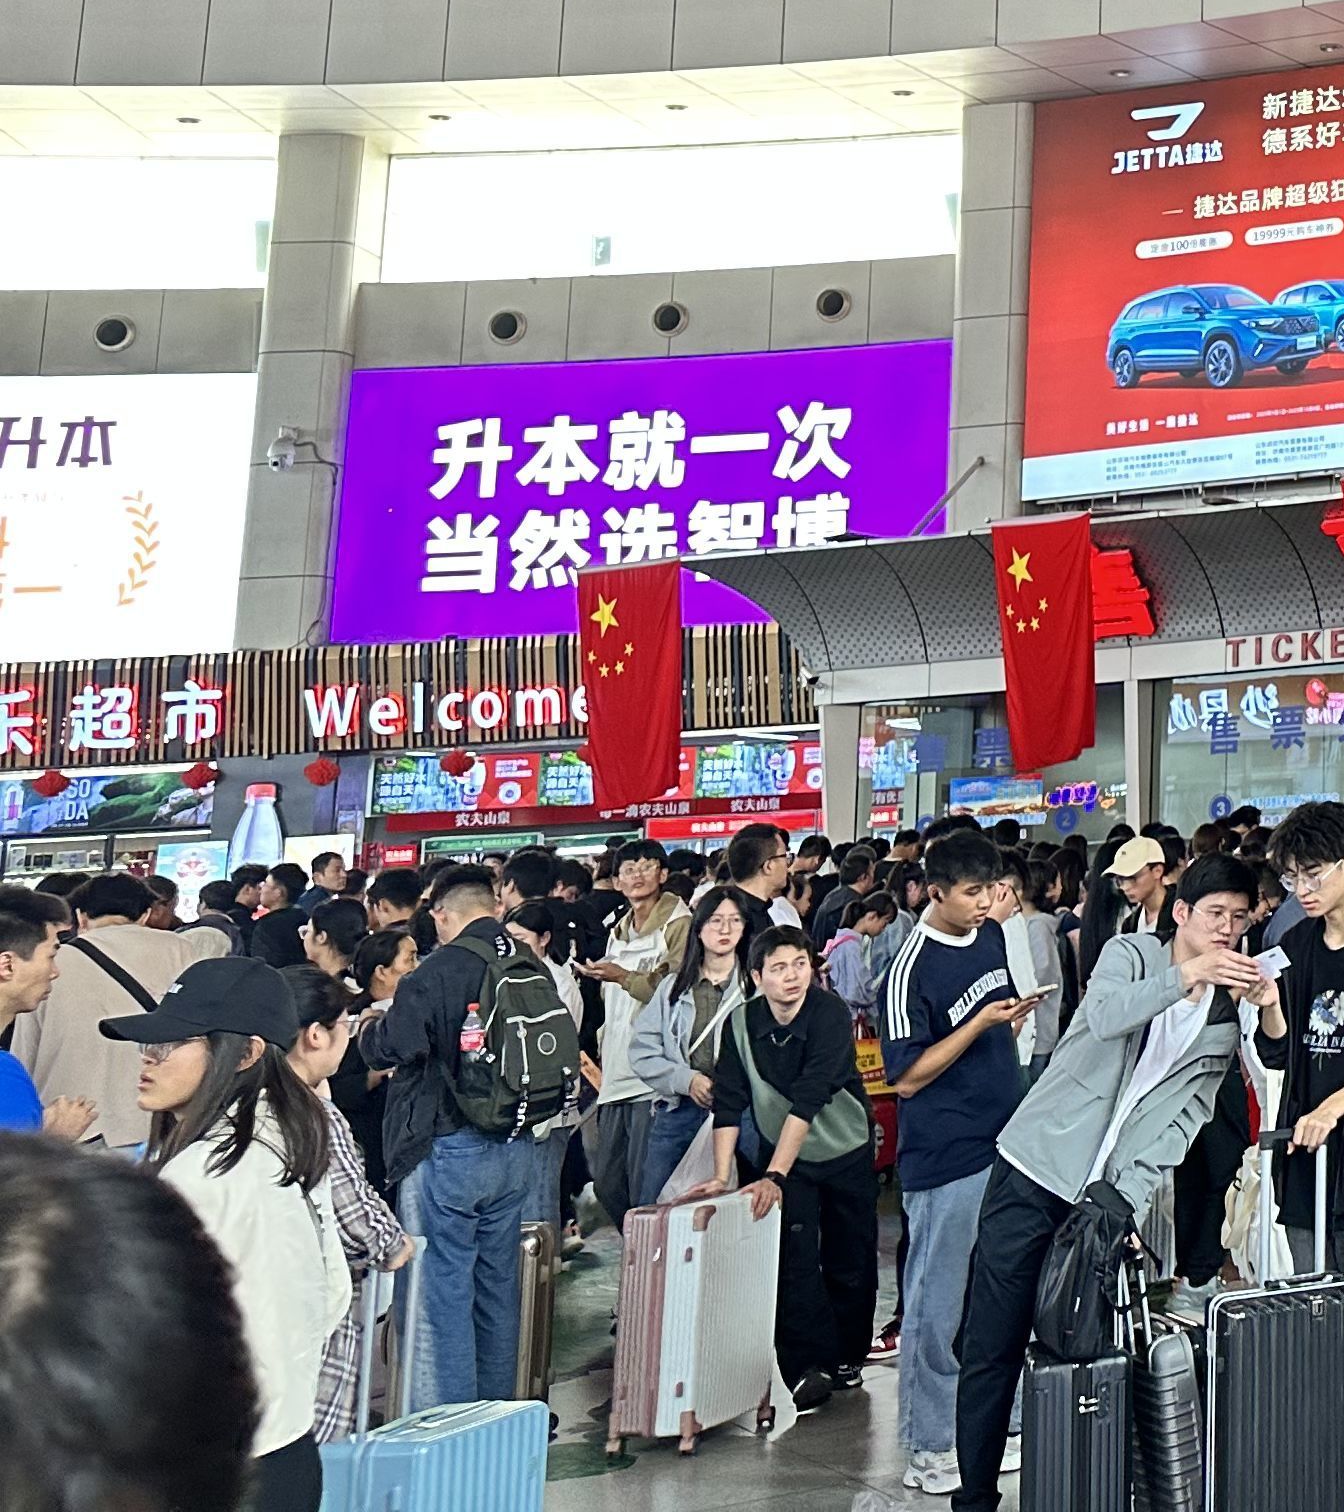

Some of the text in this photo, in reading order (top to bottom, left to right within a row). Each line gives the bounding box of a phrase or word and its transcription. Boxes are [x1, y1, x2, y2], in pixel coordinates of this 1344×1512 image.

[430, 401, 854, 500] 升本就一次
[1216, 801, 1226, 817] 3
[1061, 810, 1071, 826] 2
